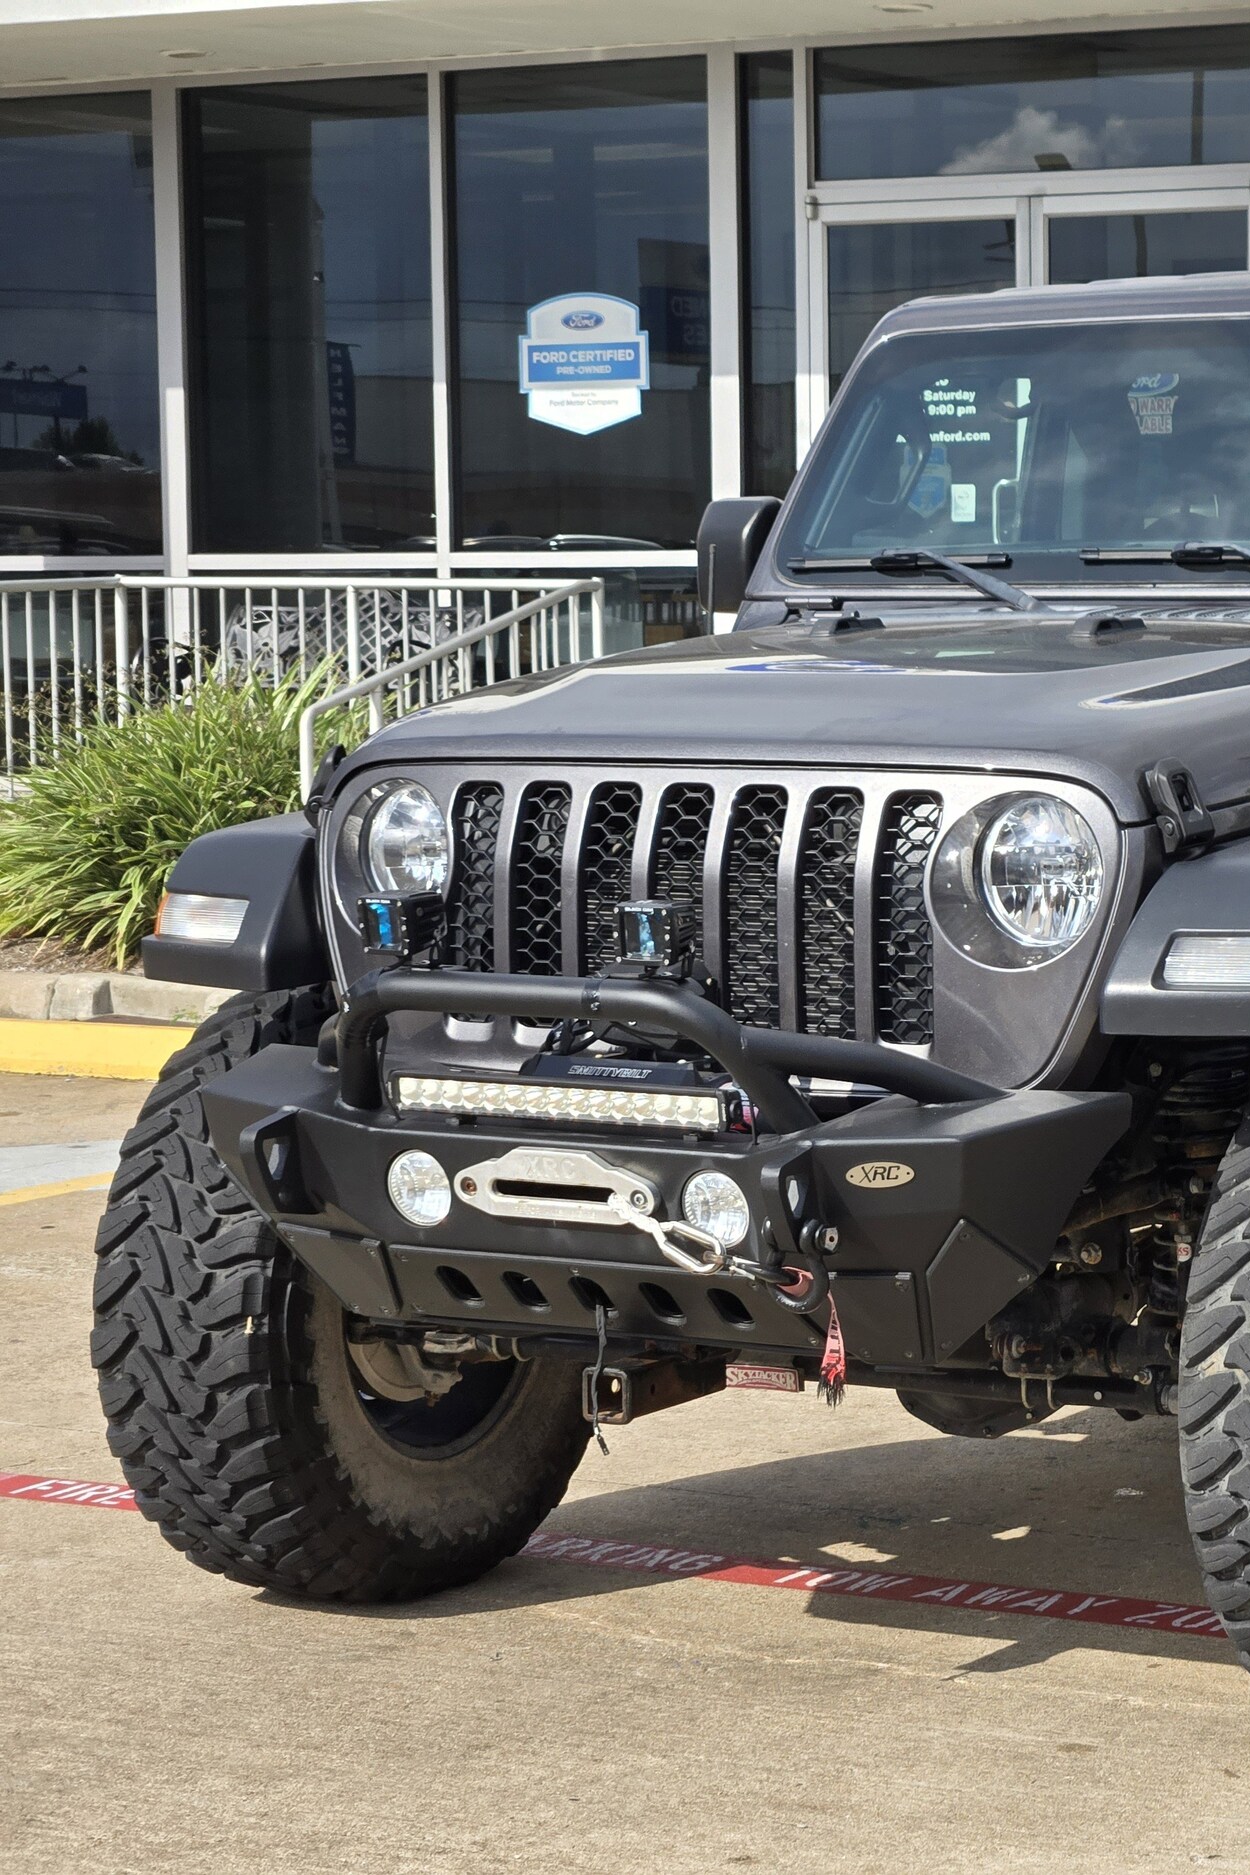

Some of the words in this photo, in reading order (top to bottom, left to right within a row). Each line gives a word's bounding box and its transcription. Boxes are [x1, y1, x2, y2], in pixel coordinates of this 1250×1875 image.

[569, 313, 597, 328] Ford
[532, 350, 568, 364] FORD
[569, 348, 635, 362] CERTIFIED
[556, 364, 612, 375] PRE-OWNED
[1131, 373, 1162, 388] ord
[923, 389, 976, 403] Saturday
[927, 404, 955, 416] 9:00
[957, 404, 977, 418] pm
[1138, 396, 1174, 415] WARR
[1137, 416, 1172, 434] ABLE
[930, 430, 991, 443] nford.com
[567, 1065, 653, 1079] SMITTYBILT
[522, 1156, 576, 1180] XRC
[858, 1165, 901, 1184] XRC
[726, 1367, 796, 1391] SKYJACKER
[773, 1565, 914, 1593] TOW
[911, 1583, 1119, 1616] AWAY
